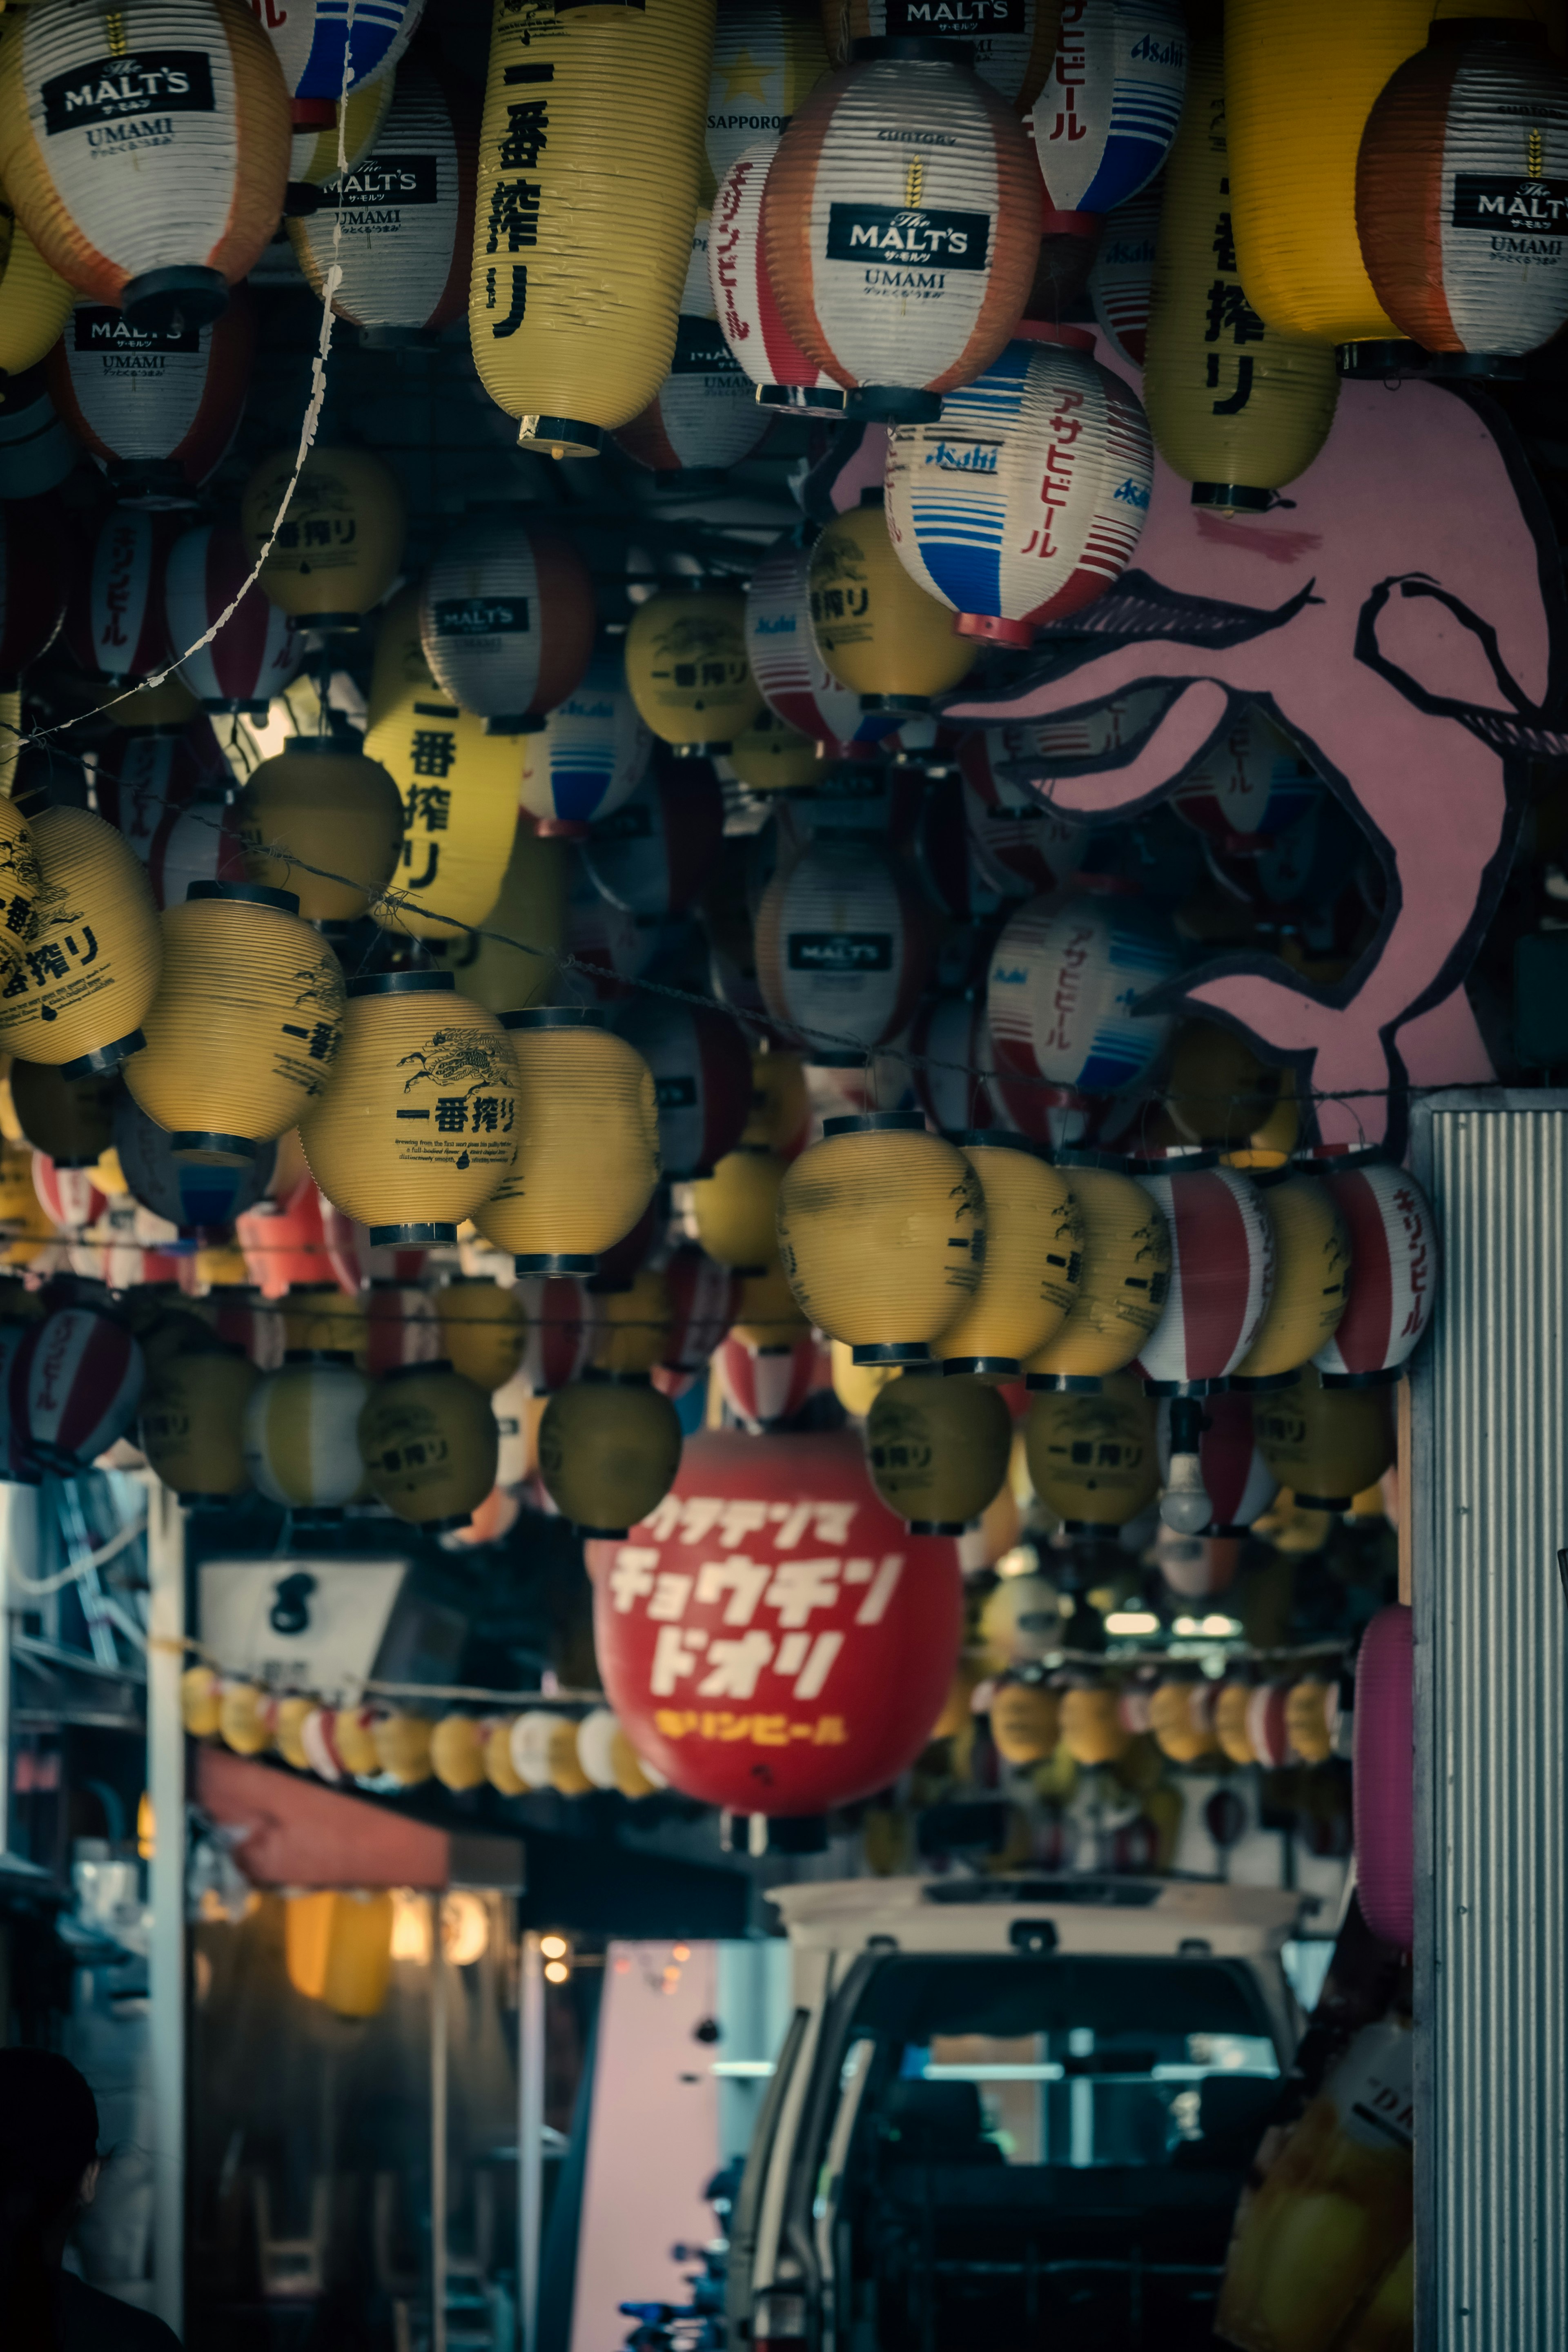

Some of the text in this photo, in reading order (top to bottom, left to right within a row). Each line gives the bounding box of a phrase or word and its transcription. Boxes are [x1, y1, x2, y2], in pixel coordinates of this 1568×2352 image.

[907, 0, 1009, 21] MALT'S
[1131, 33, 1182, 68] Asahi
[100, 59, 144, 78] The
[64, 66, 190, 111] MALT'S
[86, 118, 172, 146] UMAMI
[707, 116, 781, 129] SAPPORO
[356, 160, 382, 173] The
[348, 194, 385, 203] ザ・モルツ
[1515, 182, 1551, 197] The
[486, 64, 555, 339] 一番搾り
[1477, 194, 1568, 220] MALT'
[335, 210, 401, 225] UMAMI
[889, 212, 931, 227] The
[341, 224, 401, 234] ッとくる‘うまみ’
[849, 224, 968, 254] MALT'S
[1106, 240, 1156, 264] Asah
[1491, 236, 1562, 255] UMAMI
[865, 269, 945, 289] UMAMI
[103, 356, 166, 368] UMAMI
[704, 376, 753, 388] UMAM
[1021, 388, 1084, 558] アサヒビール
[396, 1096, 514, 1132] 一番搾り
[1393, 1189, 1427, 1338] キリンビール
[609, 1546, 905, 1628] チョウチン
[650, 1624, 845, 1700] ドオリ
